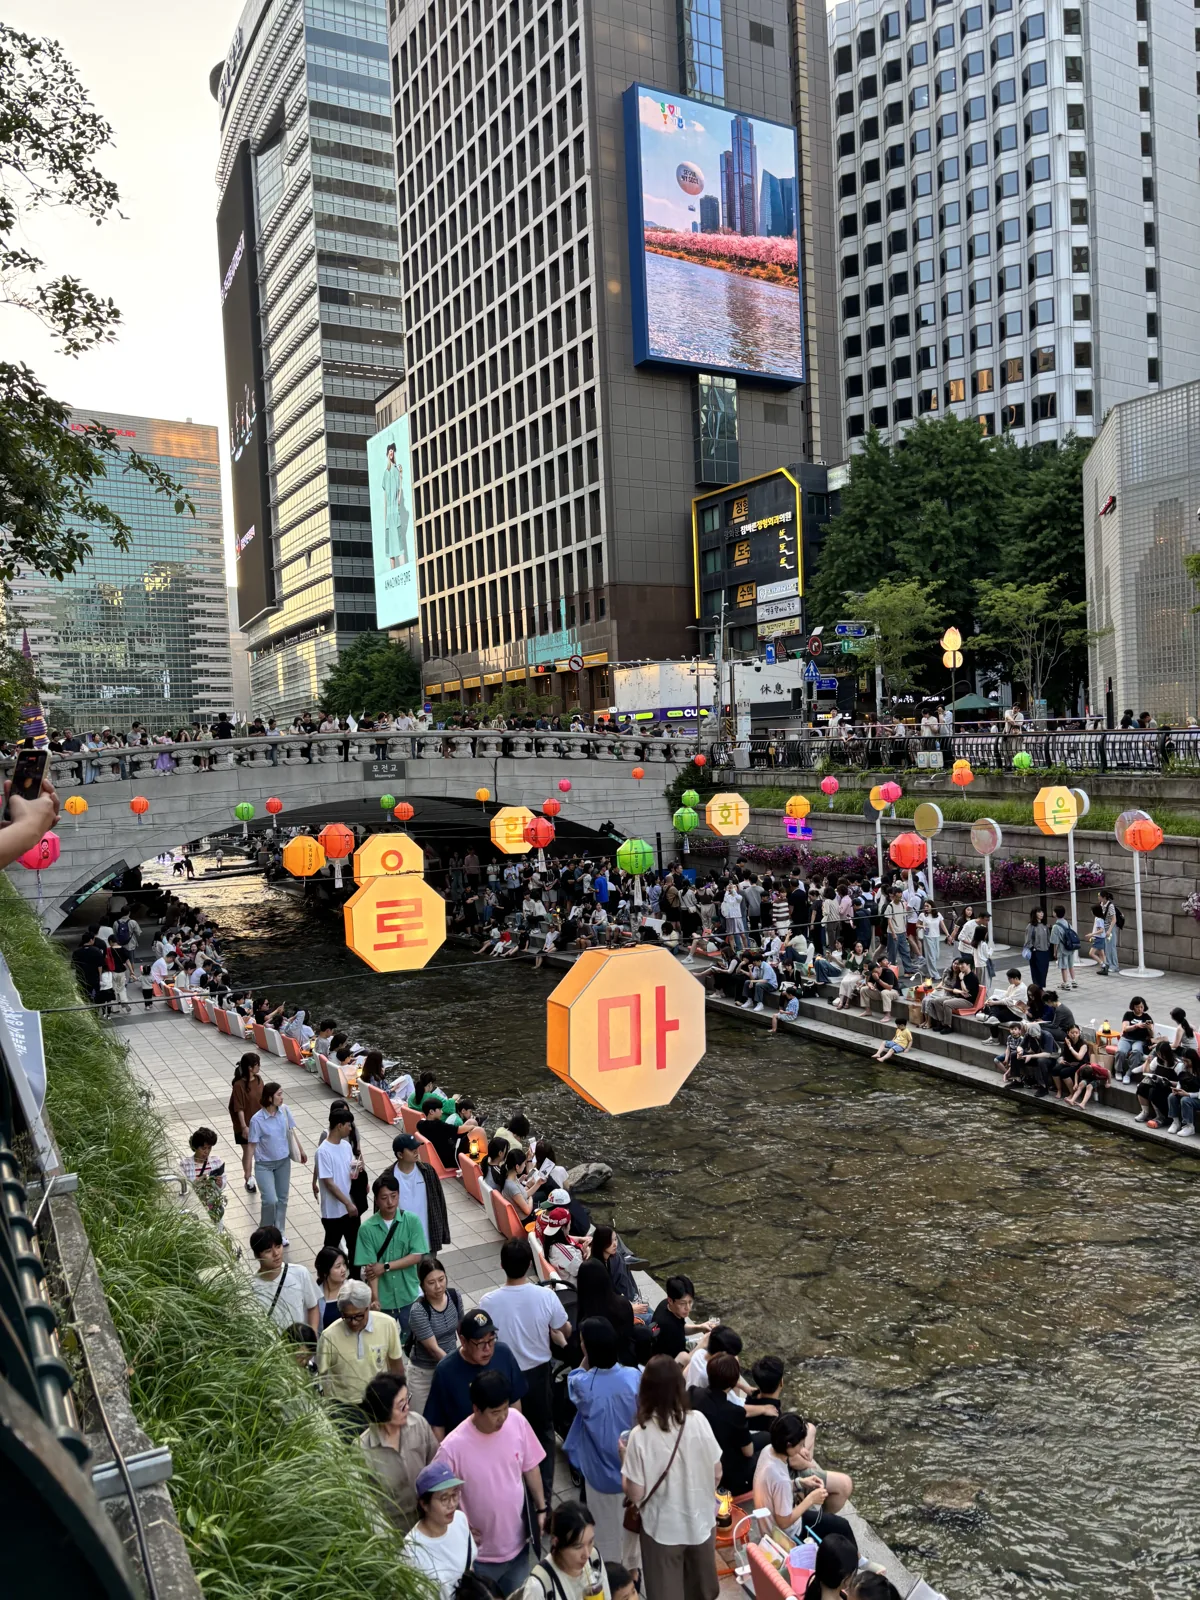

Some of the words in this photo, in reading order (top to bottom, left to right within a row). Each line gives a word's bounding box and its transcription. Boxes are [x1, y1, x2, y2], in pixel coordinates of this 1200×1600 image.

[760, 682, 784, 695] 休息
[683, 708, 698, 717] CU
[717, 802, 743, 826] 화
[373, 898, 429, 951] 로
[597, 985, 680, 1073] 마
